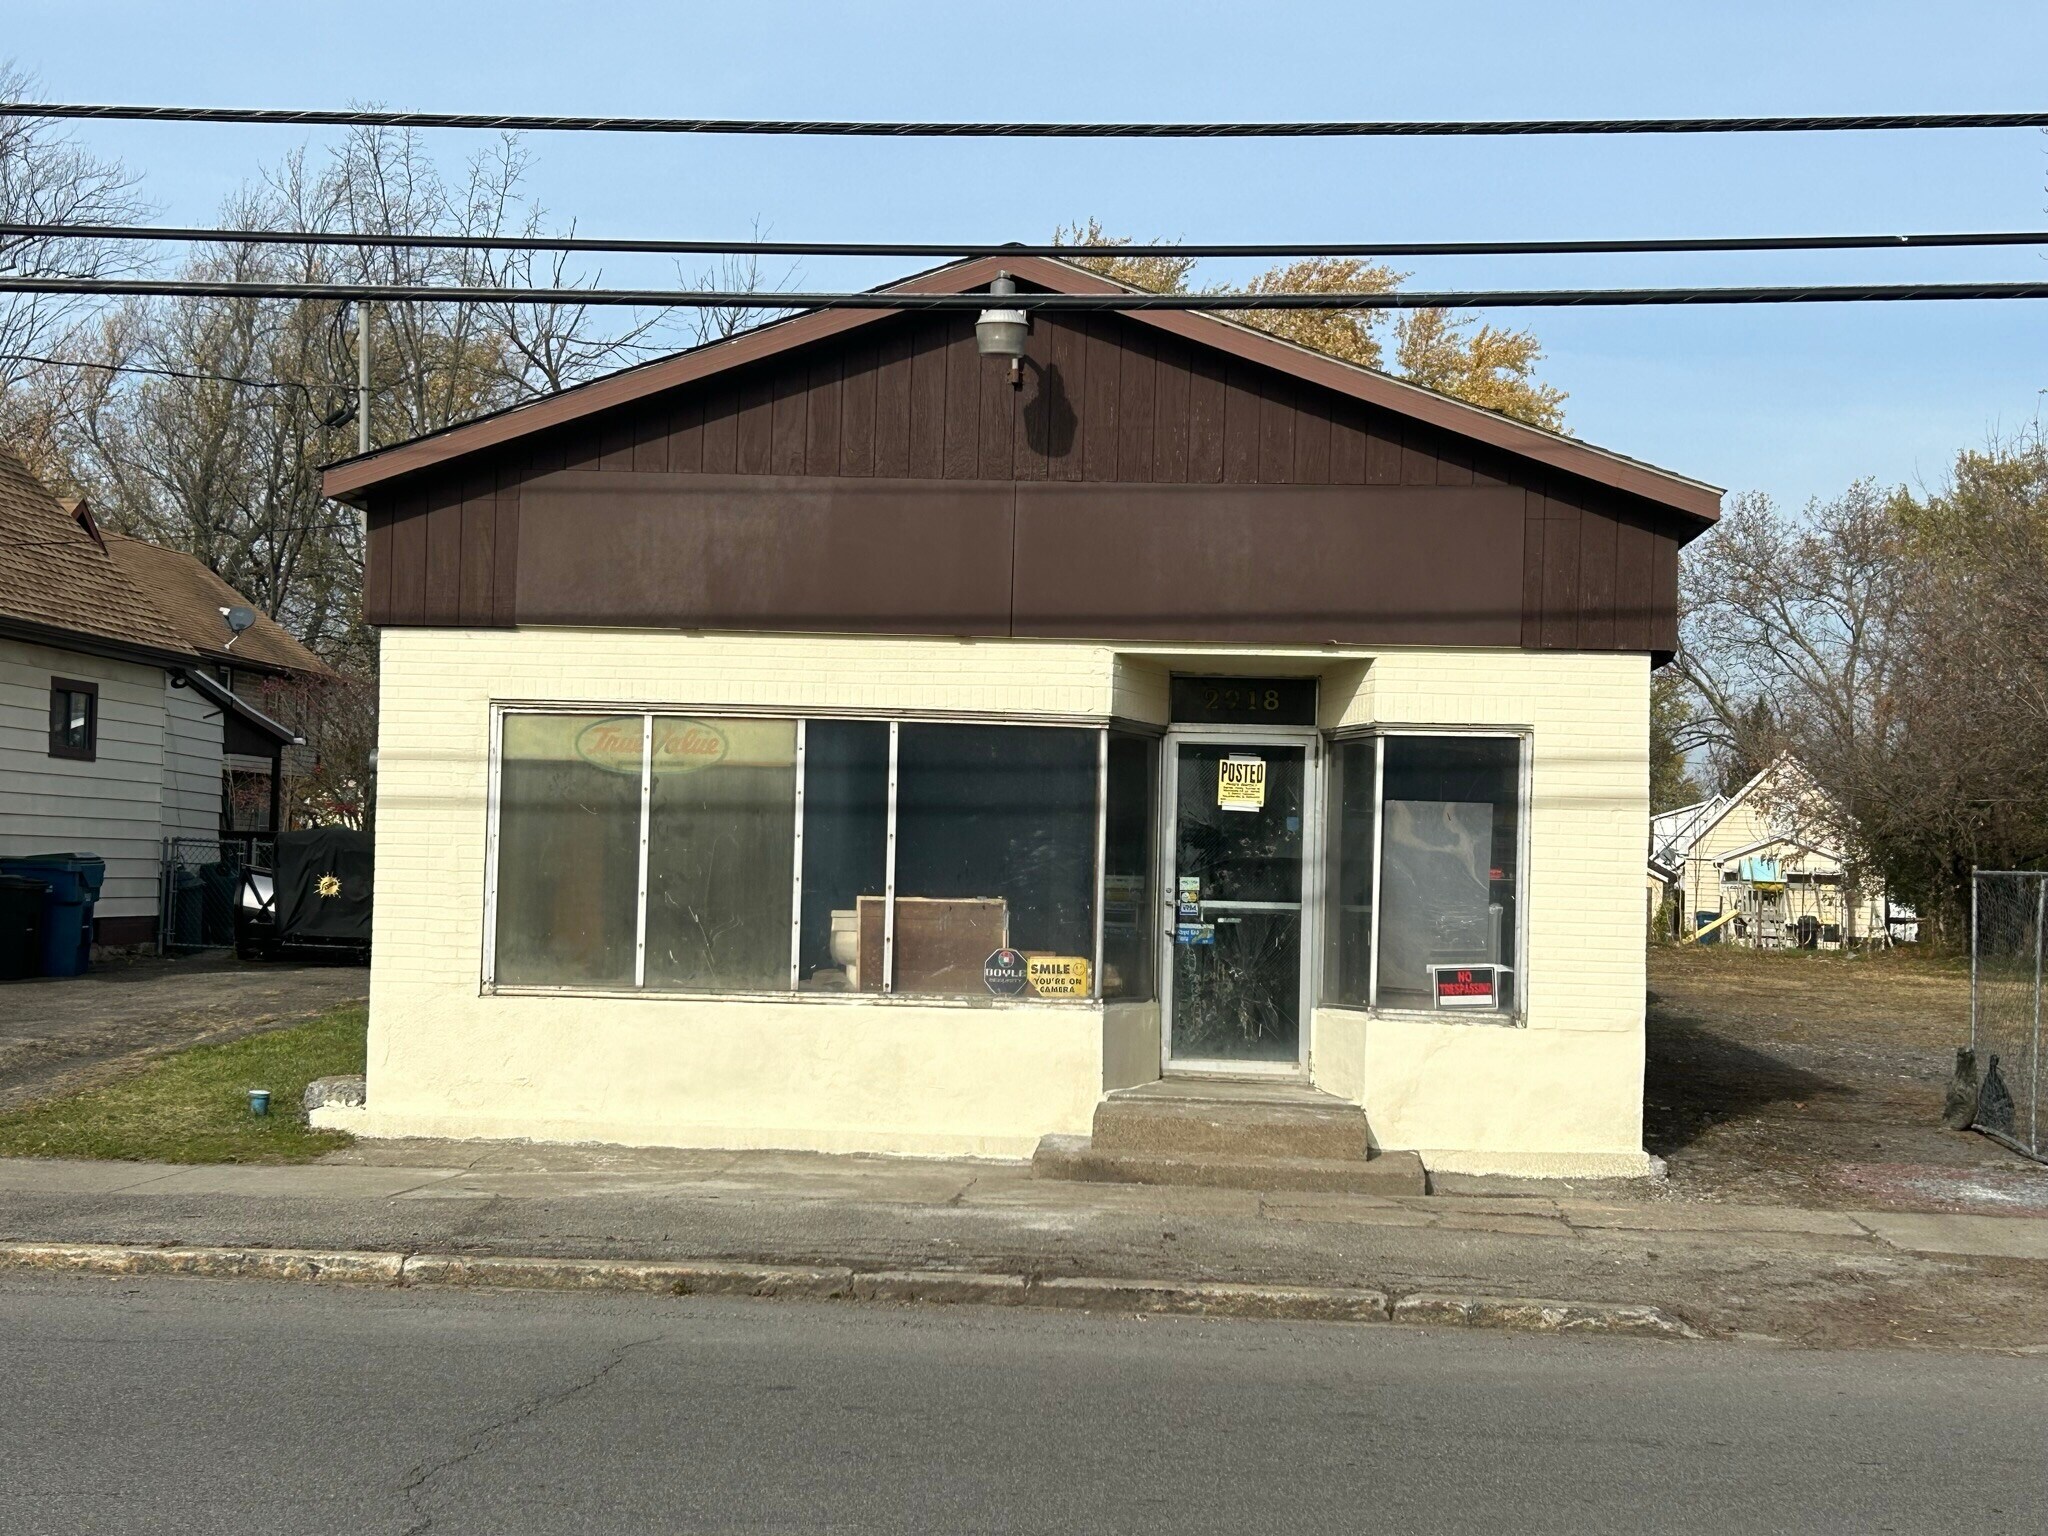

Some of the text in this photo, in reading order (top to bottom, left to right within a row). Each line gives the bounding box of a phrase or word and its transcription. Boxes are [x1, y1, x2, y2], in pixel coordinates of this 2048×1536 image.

[1221, 761, 1263, 783] POSTED
[985, 968, 1027, 978] DOYLE
[1030, 964, 1070, 975] SMILE
[1034, 977, 1082, 985] YOU'RE ON
[1457, 971, 1472, 983] NO
[1039, 985, 1075, 993] CAMERA
[1439, 983, 1492, 995] TRESPASSING
